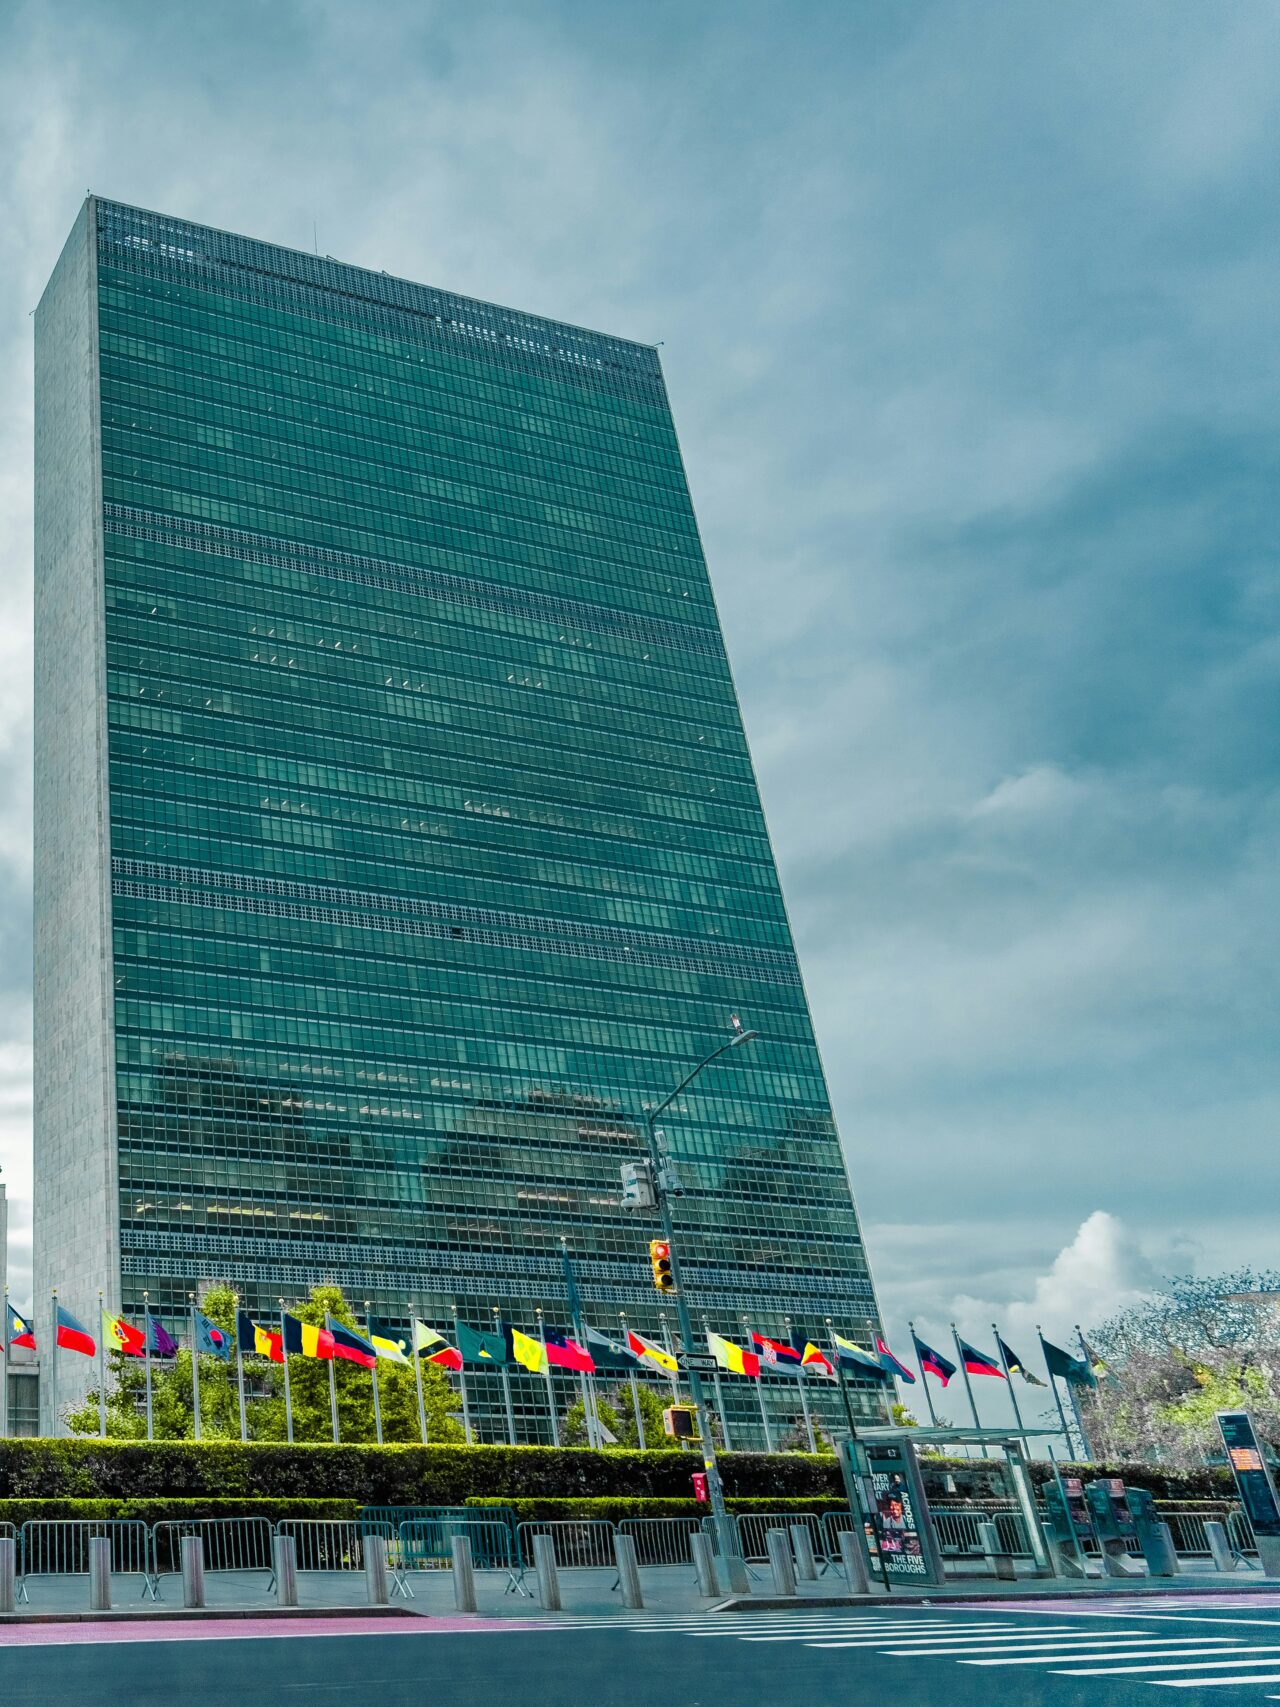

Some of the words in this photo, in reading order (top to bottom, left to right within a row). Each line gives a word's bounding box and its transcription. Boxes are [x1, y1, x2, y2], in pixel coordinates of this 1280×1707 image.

[680, 1357, 695, 1366] ONE
[701, 1359, 714, 1367] WAY
[900, 1491, 915, 1529] ACROSS
[891, 1554, 907, 1564] THE
[907, 1555, 924, 1565] FIVE
[884, 1562, 926, 1574] BOROUGHS
